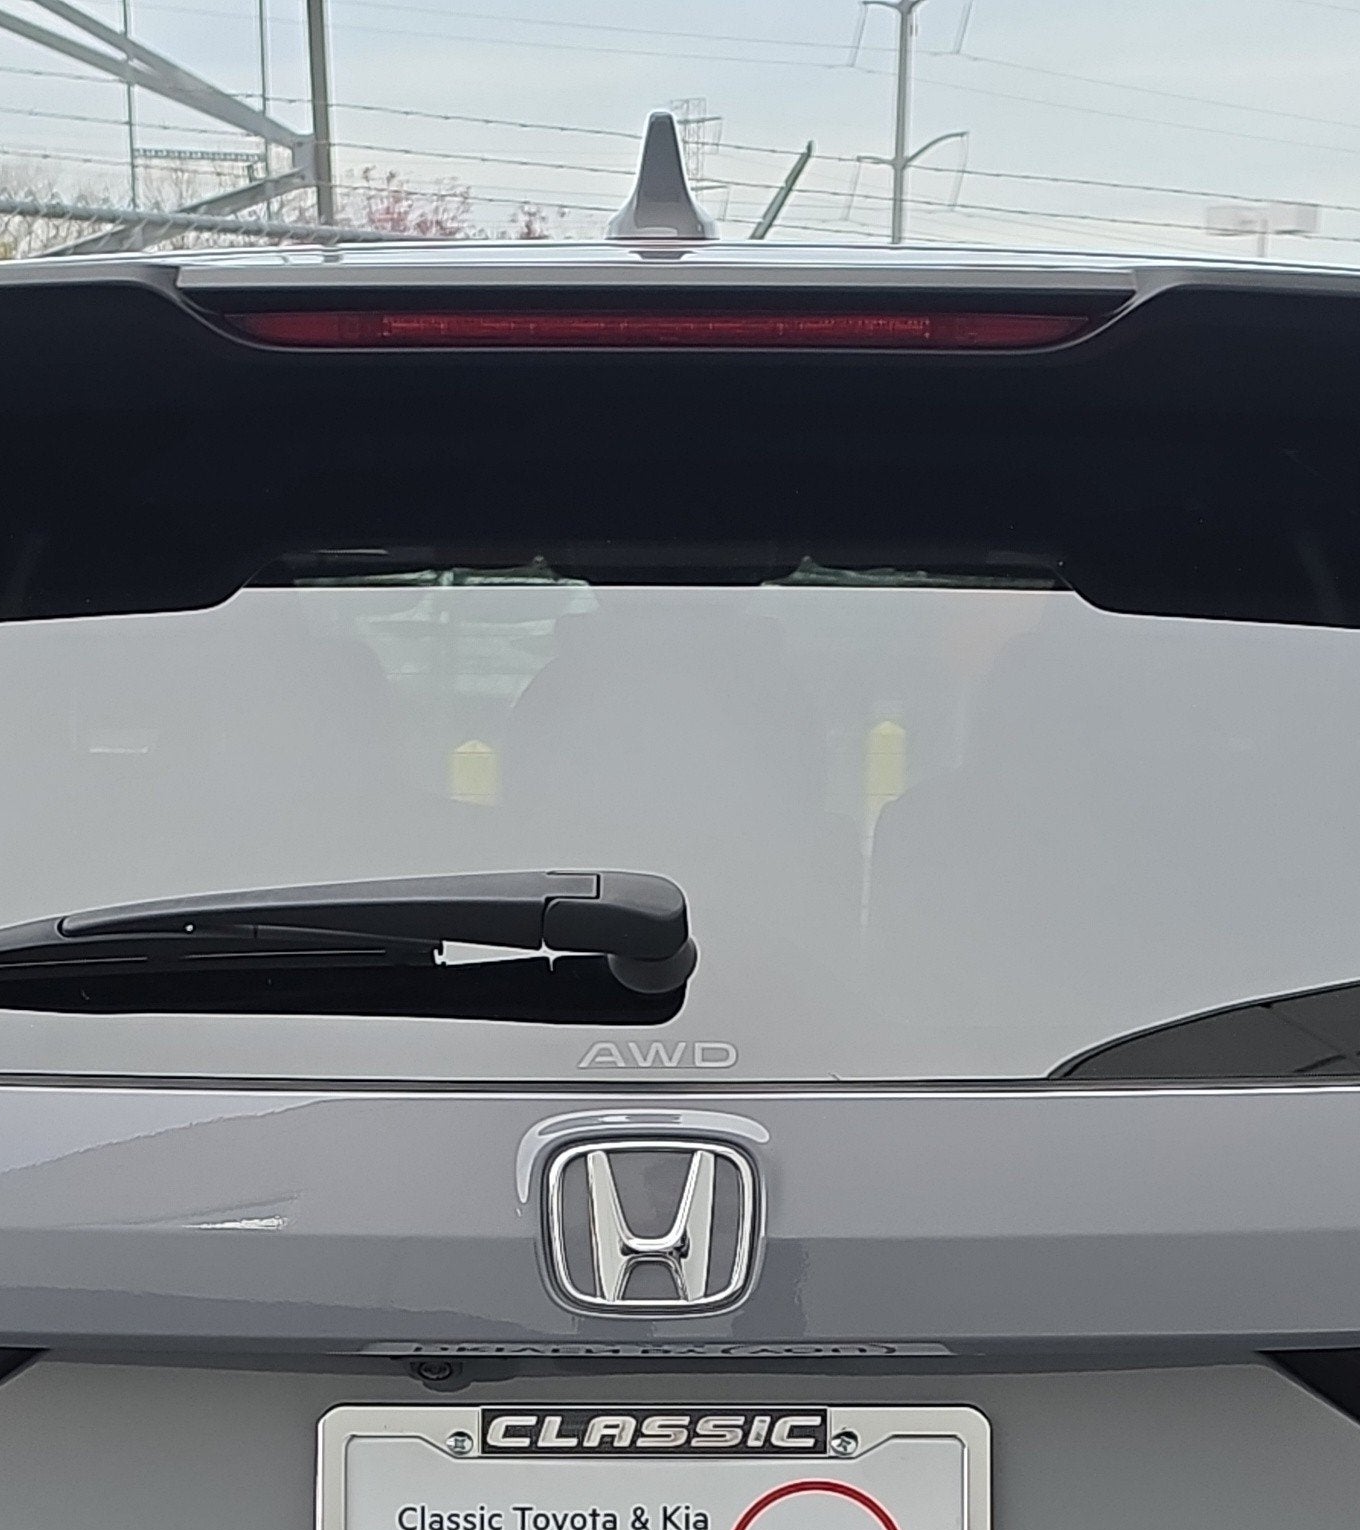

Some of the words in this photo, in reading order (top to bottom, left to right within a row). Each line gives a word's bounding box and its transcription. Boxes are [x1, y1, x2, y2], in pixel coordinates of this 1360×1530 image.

[578, 1041, 738, 1068] AWD
[486, 1415, 823, 1449] CLASSIC
[662, 1506, 709, 1530] Kia
